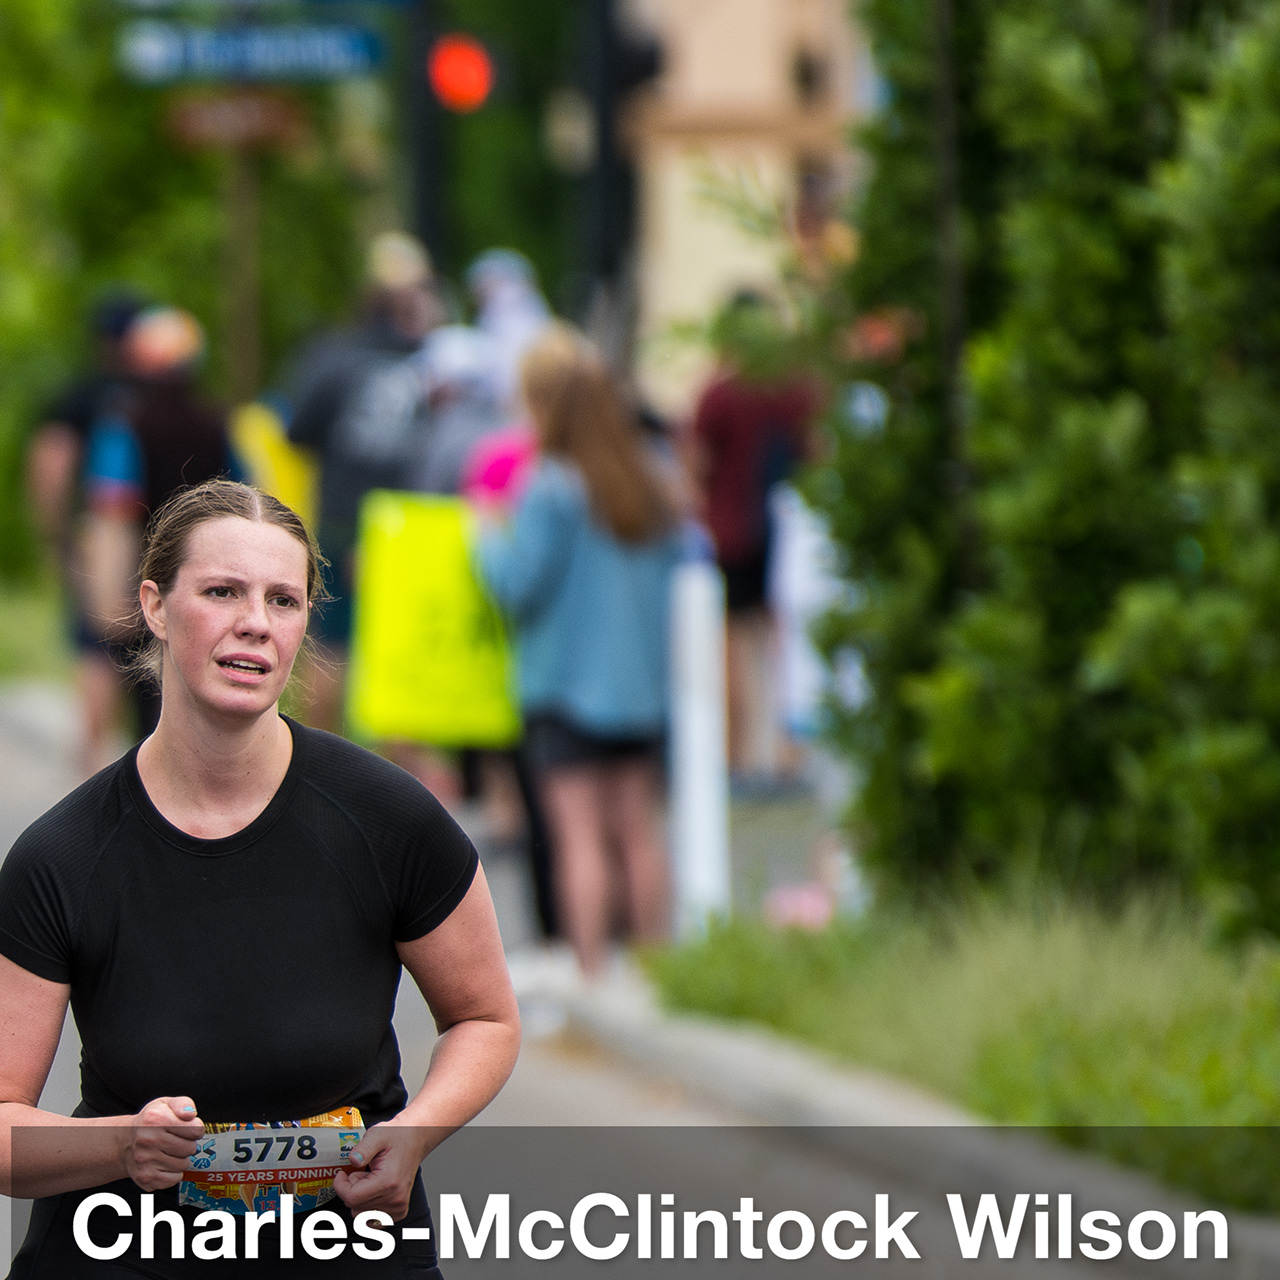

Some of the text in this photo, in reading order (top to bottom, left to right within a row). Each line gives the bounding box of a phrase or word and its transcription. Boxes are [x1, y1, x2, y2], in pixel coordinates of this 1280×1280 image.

[232, 1135, 318, 1164] 5778
[207, 1173, 223, 1182] 25
[228, 1170, 275, 1182] YEARS
